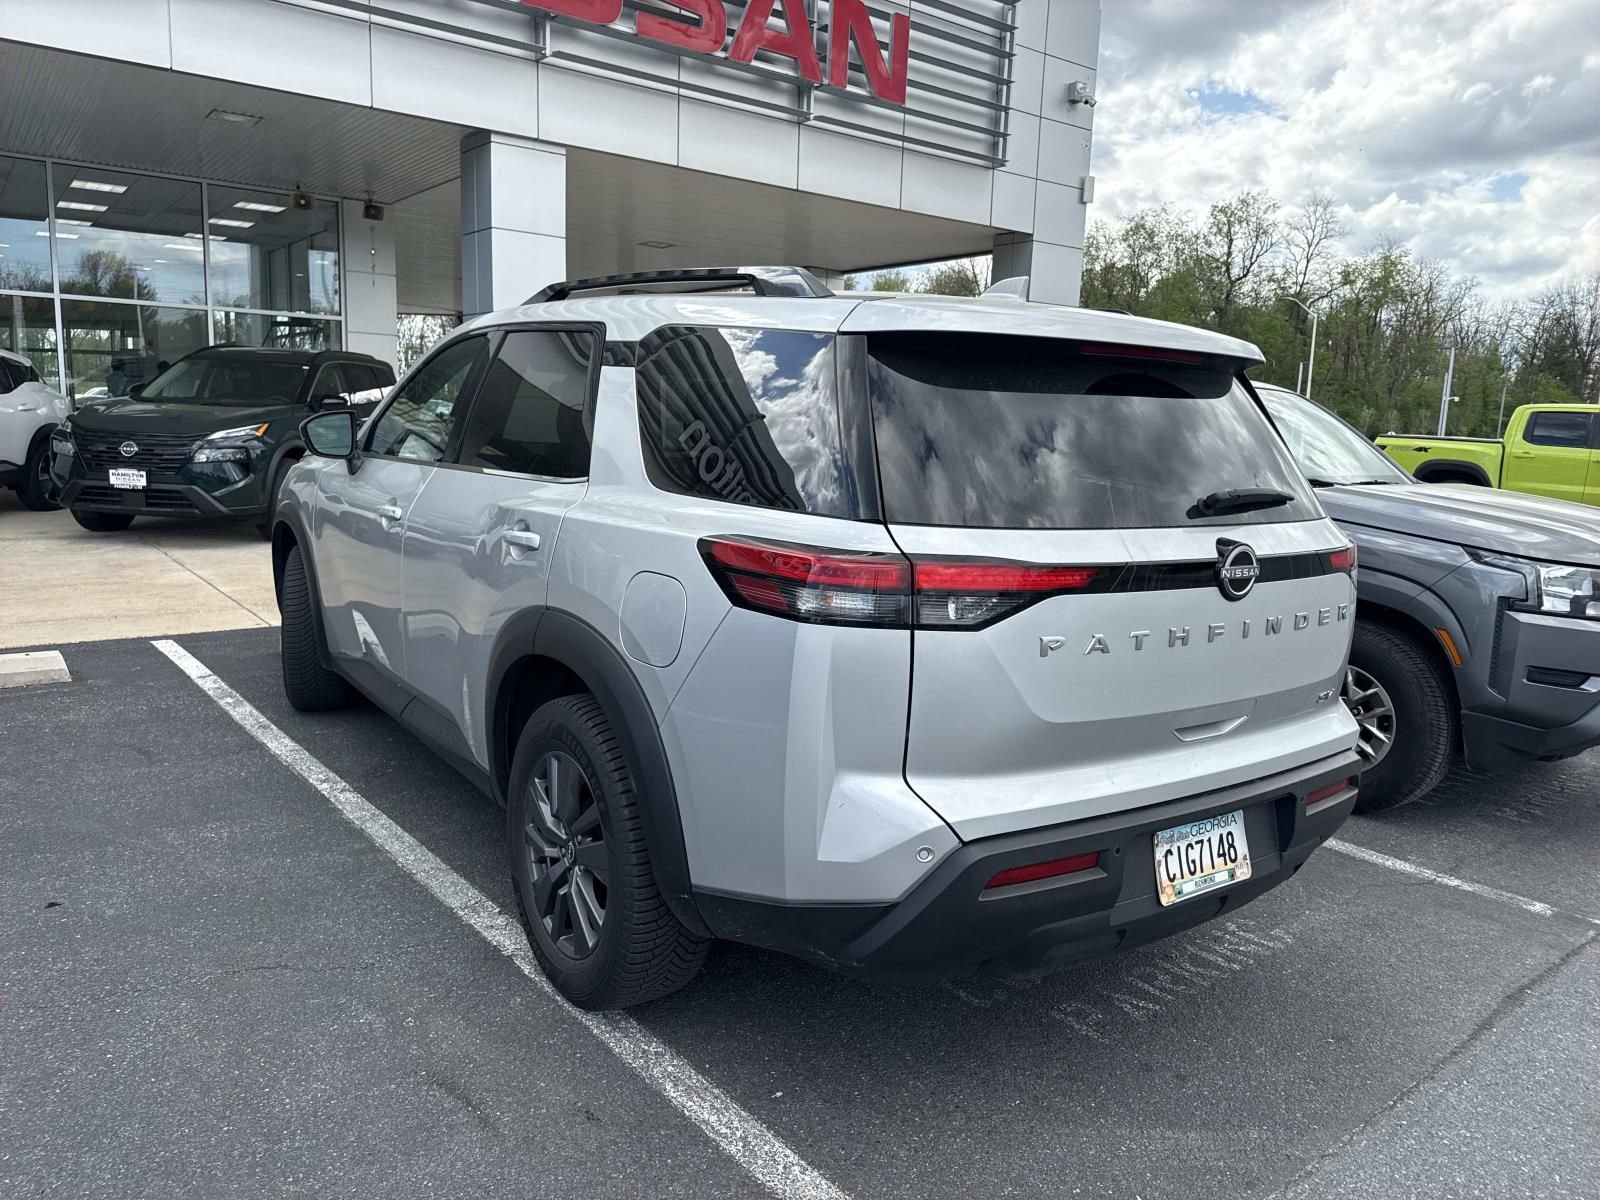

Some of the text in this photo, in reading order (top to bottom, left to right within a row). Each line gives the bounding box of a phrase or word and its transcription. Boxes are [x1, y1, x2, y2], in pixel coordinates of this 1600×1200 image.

[519, 0, 910, 106] SAN
[1222, 567, 1260, 578] NISSAN
[1039, 603, 1349, 658] PATHFINDER
[1190, 814, 1237, 837] GEORGIA
[1164, 831, 1238, 883] CIG7148
